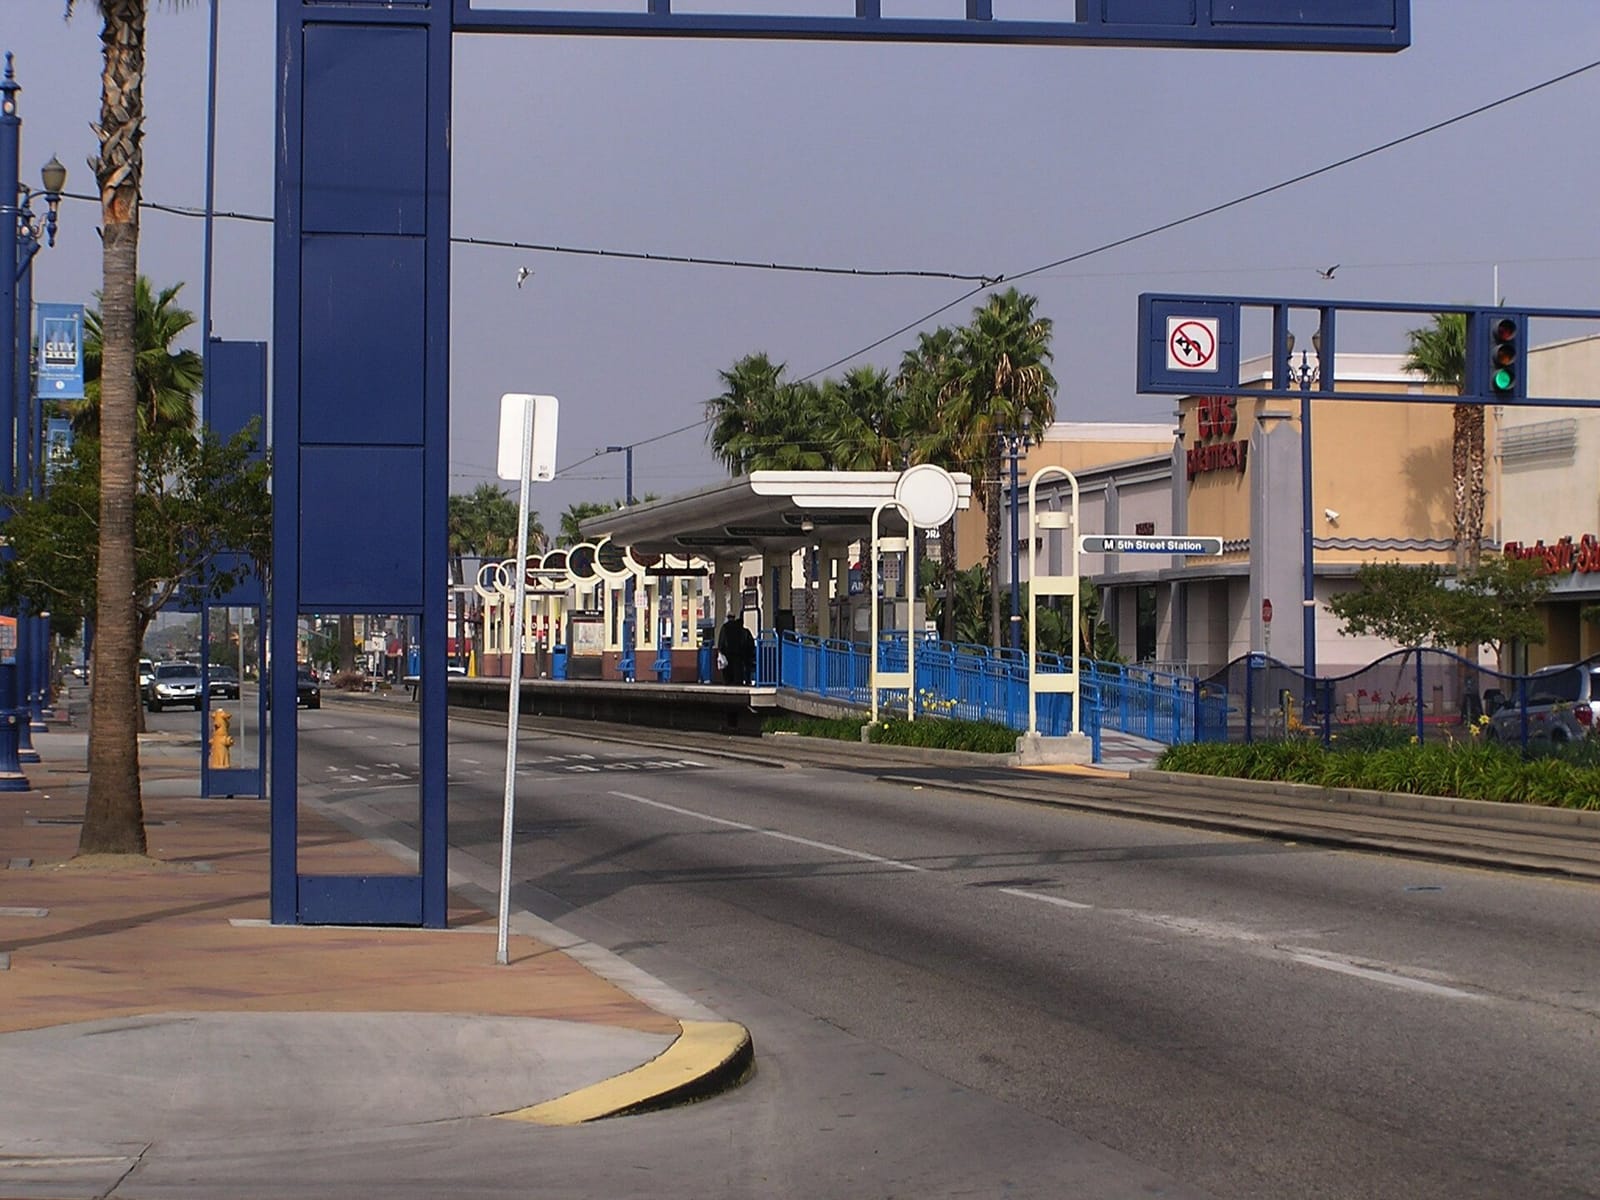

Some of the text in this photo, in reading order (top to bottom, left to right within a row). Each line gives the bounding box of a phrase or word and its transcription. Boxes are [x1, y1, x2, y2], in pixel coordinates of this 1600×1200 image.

[46, 342, 74, 351] CITY
[1198, 396, 1236, 439] CVS
[1118, 540, 1134, 550] 5th
[1136, 540, 1165, 550] Street
[1168, 541, 1201, 551] Station
